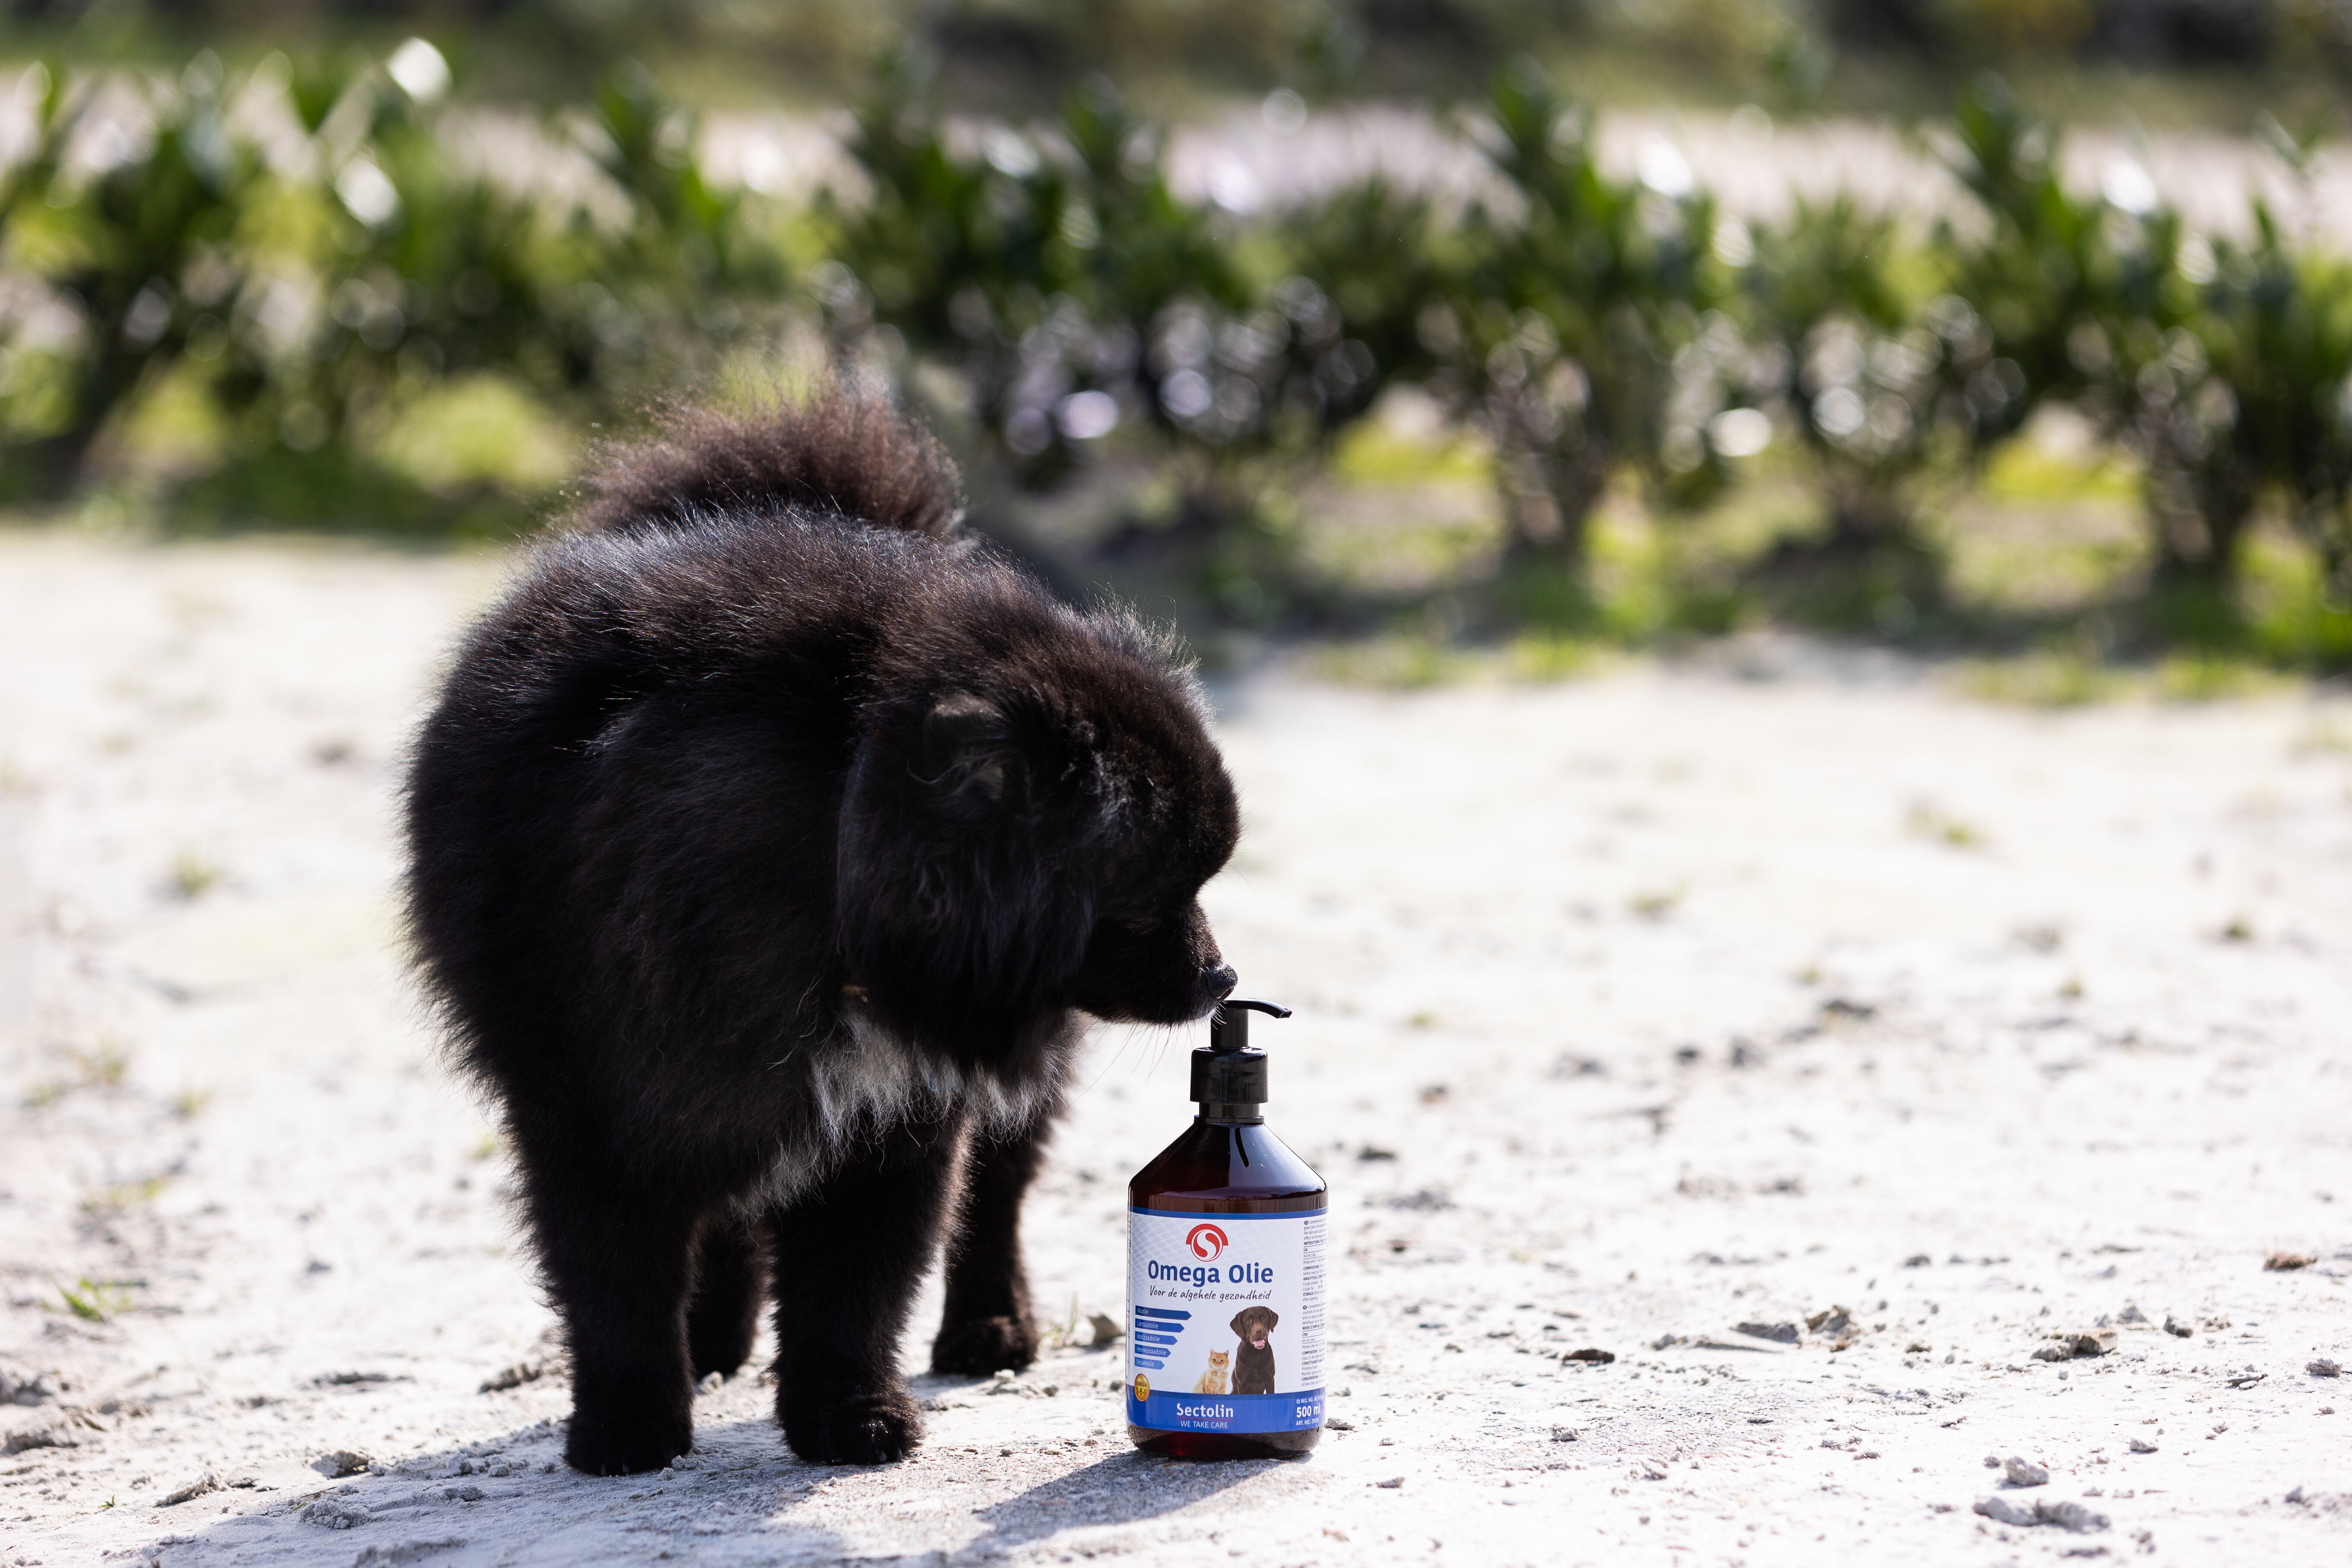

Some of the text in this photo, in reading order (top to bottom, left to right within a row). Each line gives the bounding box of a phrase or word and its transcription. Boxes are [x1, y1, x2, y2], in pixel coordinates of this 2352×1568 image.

[1148, 1260, 1273, 1288] Omega Olie
[1150, 1285, 1272, 1303] Voor de algehele gezondheid
[1137, 1320, 1158, 1329] Lijnzaadolie
[1137, 1333, 1160, 1342] Koolzaadolie
[1136, 1346, 1166, 1355] Hennepzaadolie
[1136, 1358, 1154, 1367] Sesamolie
[1177, 1403, 1233, 1418] Sectolin
[1296, 1402, 1321, 1418] 500 ml
